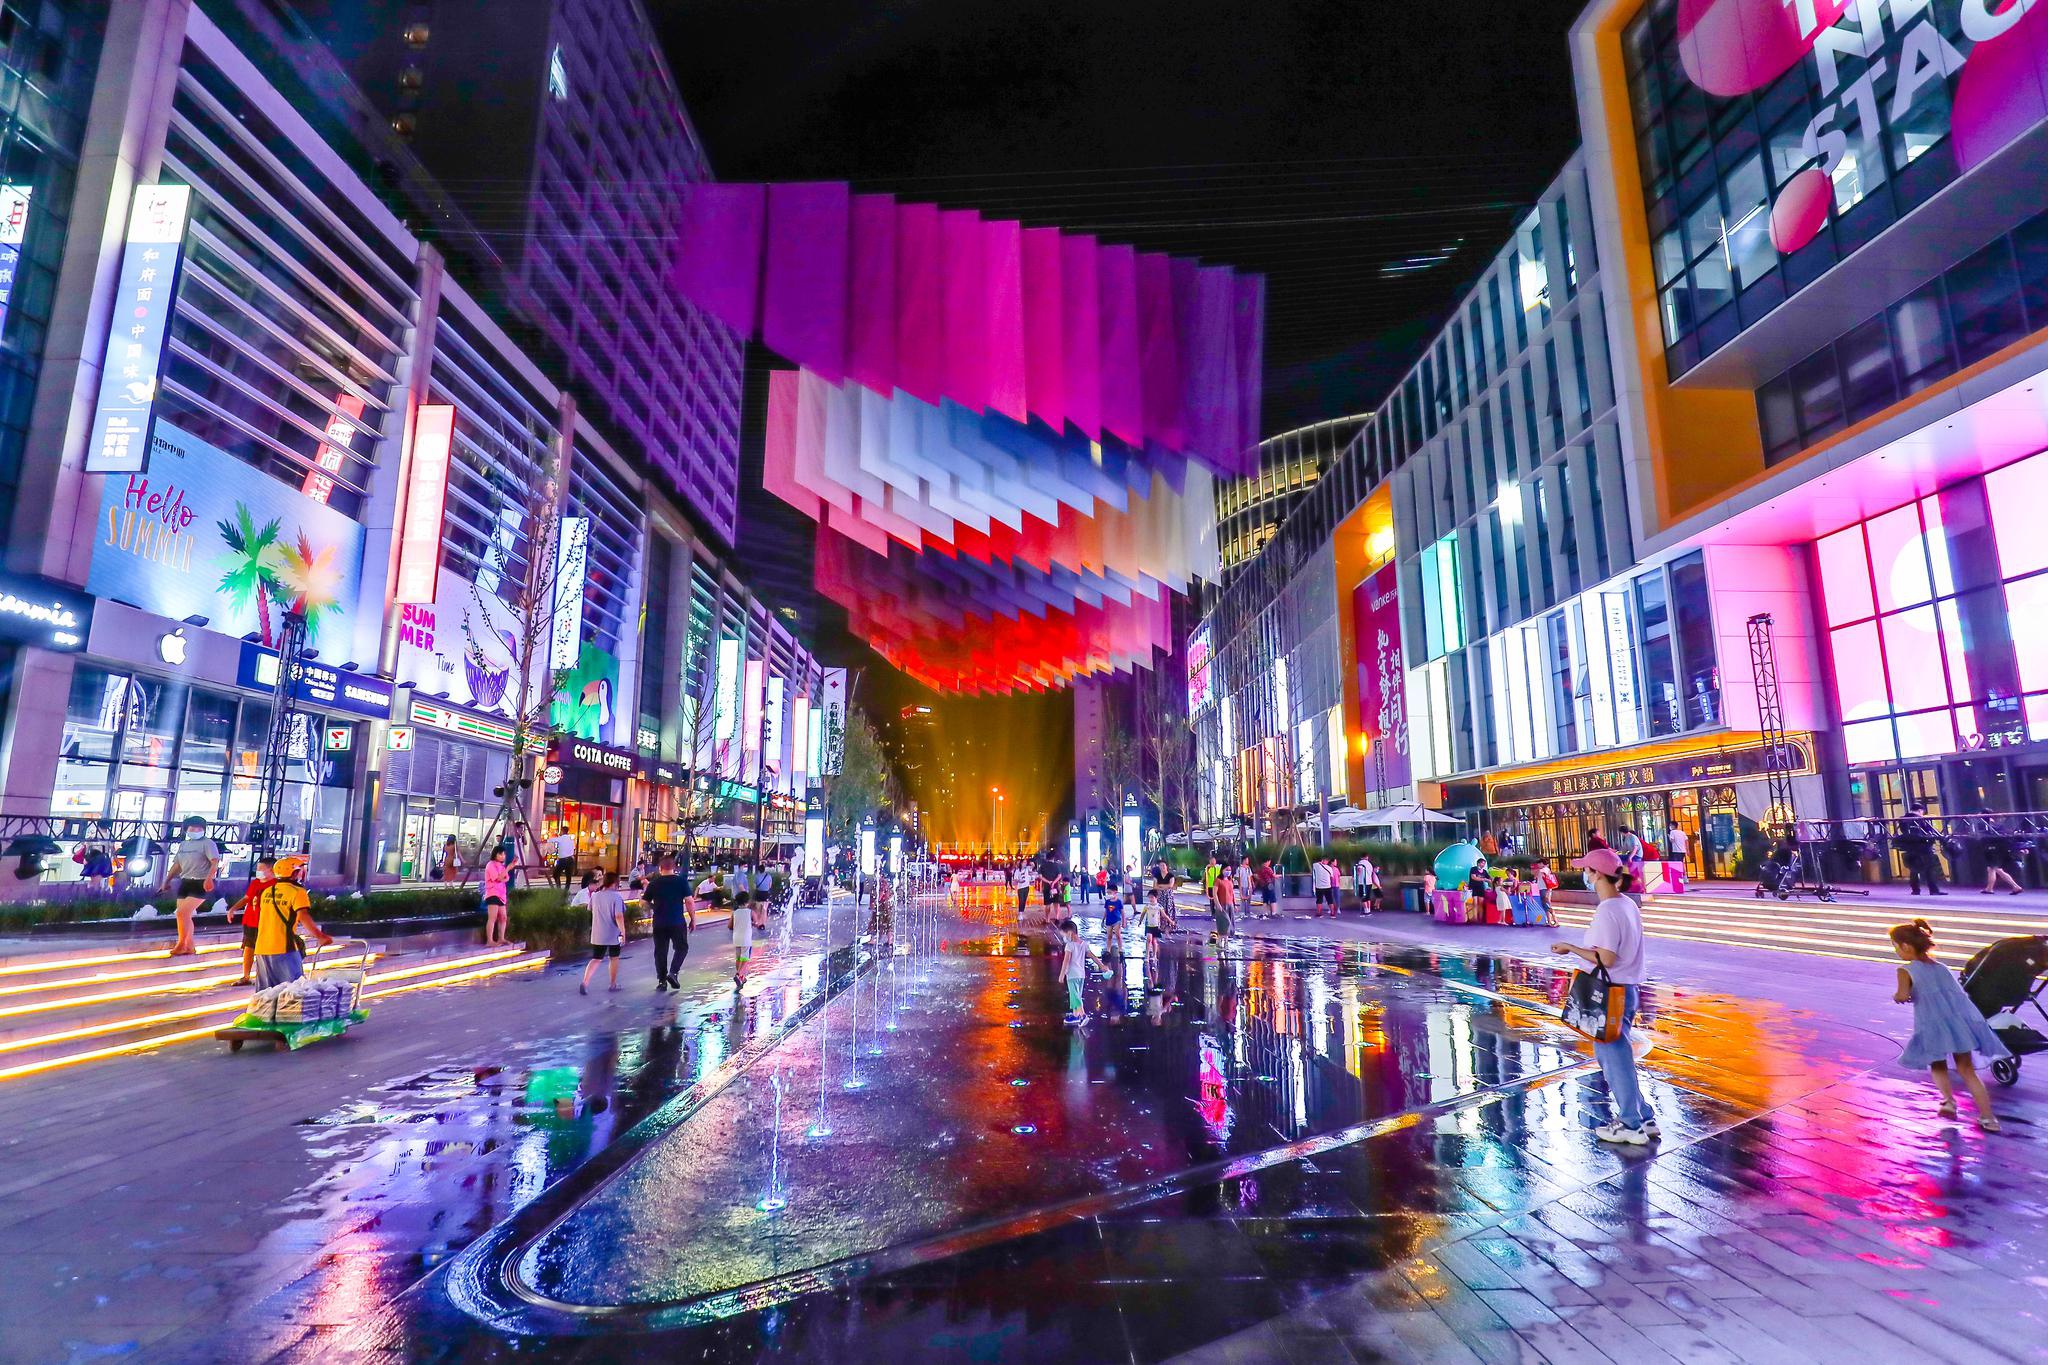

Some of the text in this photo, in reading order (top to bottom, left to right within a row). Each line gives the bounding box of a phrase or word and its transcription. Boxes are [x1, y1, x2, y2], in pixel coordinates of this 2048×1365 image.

[124, 473, 199, 535] Hello
[105, 505, 195, 573] SUMMER
[403, 603, 436, 631] SUM
[400, 623, 434, 652] MER
[306, 666, 337, 683] 中国移动
[435, 653, 455, 675] Time
[344, 685, 390, 707] SAMSUNG
[574, 743, 632, 771] COSTA COFFEE
